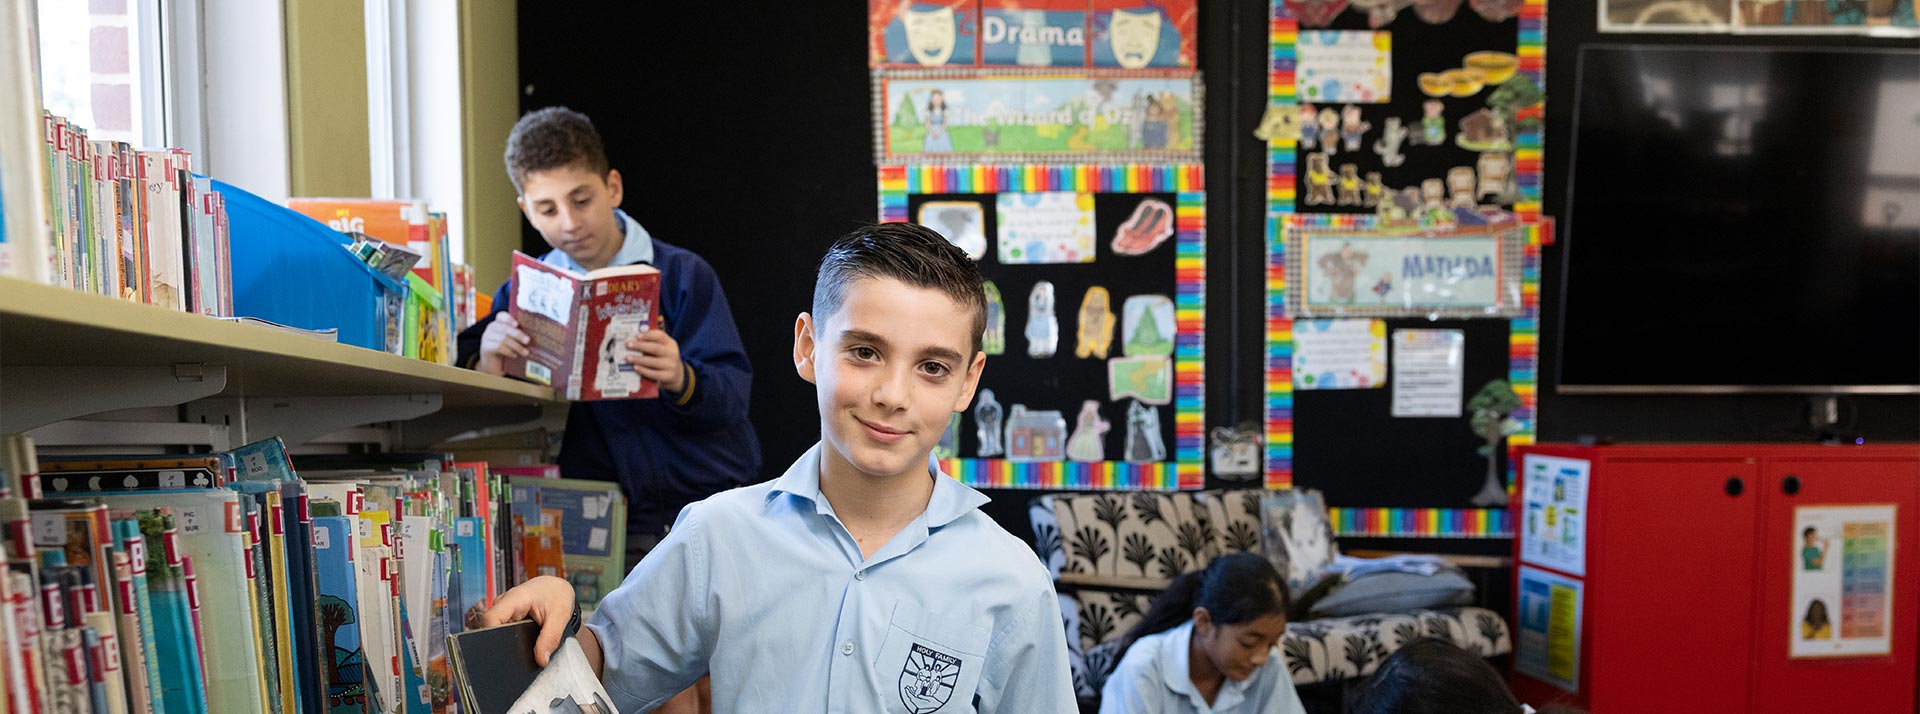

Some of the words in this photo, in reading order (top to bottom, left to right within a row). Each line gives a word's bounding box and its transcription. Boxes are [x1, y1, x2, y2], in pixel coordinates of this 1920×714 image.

[983, 15, 1085, 46] Drama
[951, 106, 990, 127] The
[996, 105, 1073, 127] Wizard
[1078, 106, 1097, 130] of
[1104, 106, 1138, 127] Oz
[328, 217, 365, 233] BIG
[1402, 255, 1494, 278] MATILDA
[608, 279, 641, 294] DIARY
[917, 646, 933, 656] HOLY
[935, 653, 957, 664] FAMILY
